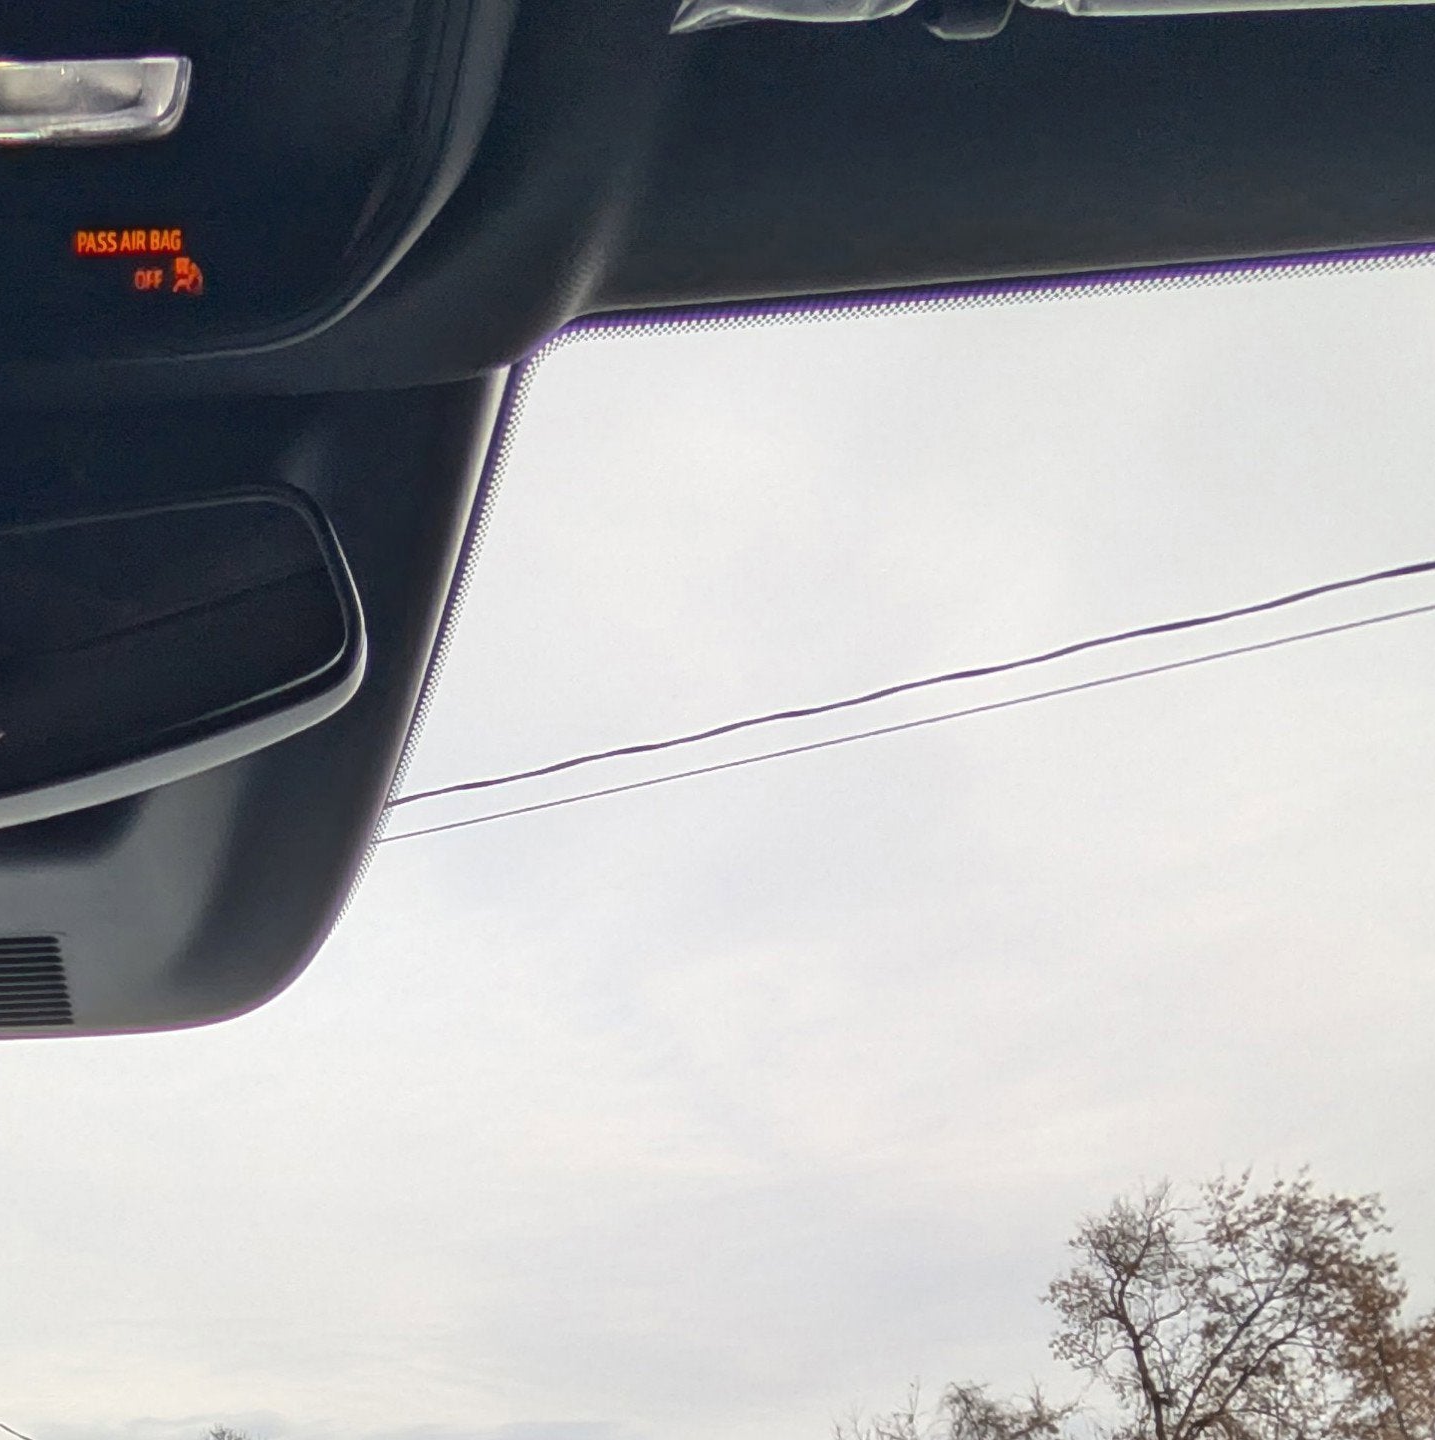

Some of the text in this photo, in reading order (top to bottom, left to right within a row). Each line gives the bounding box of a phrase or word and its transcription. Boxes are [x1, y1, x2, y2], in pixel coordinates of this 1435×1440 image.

[77, 228, 182, 253] PASS AIR BAG
[134, 269, 163, 290] OFF
